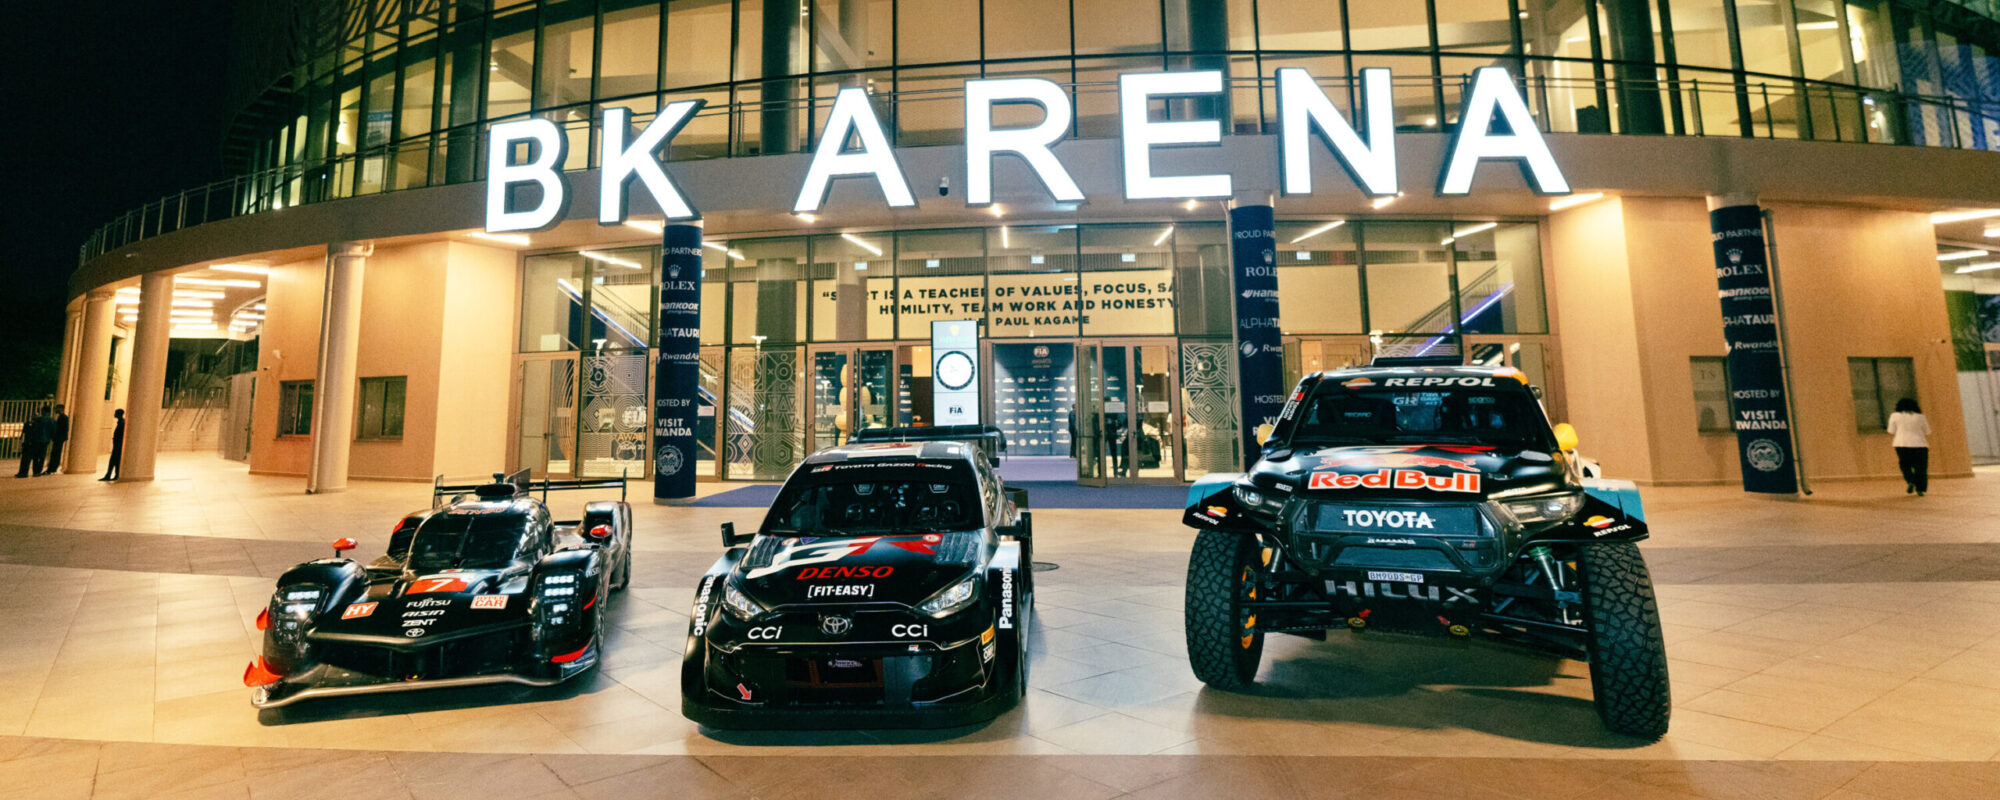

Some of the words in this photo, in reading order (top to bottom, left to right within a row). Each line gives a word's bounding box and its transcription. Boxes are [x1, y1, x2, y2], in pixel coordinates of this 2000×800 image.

[486, 98, 704, 233] BK
[792, 66, 1570, 213] ARENA
[903, 289, 913, 299] A
[995, 286, 1015, 297] OF
[1093, 282, 1152, 295] FOCUS,
[1009, 301, 1056, 312] WORK
[995, 316, 1030, 326] PAUL
[1384, 377, 1497, 388] REPSOL
[1770, 389, 1780, 398] BY
[681, 399, 691, 407] BY
[1741, 410, 1776, 420] VISIT
[658, 418, 684, 427] VISIT
[655, 427, 692, 436] WANDA
[917, 462, 953, 470] Racing
[1310, 470, 1391, 489] Red
[1395, 470, 1481, 493] Bull
[1342, 509, 1435, 529] TOYOTA
[796, 565, 895, 580] DENSO
[423, 578, 455, 592] 7
[1325, 579, 1480, 604] HILUX
[406, 597, 453, 609] FUJITSU
[474, 599, 505, 607] CAR
[345, 604, 375, 616] HY
[402, 609, 446, 618] AISIN
[402, 618, 437, 627] ZENT
